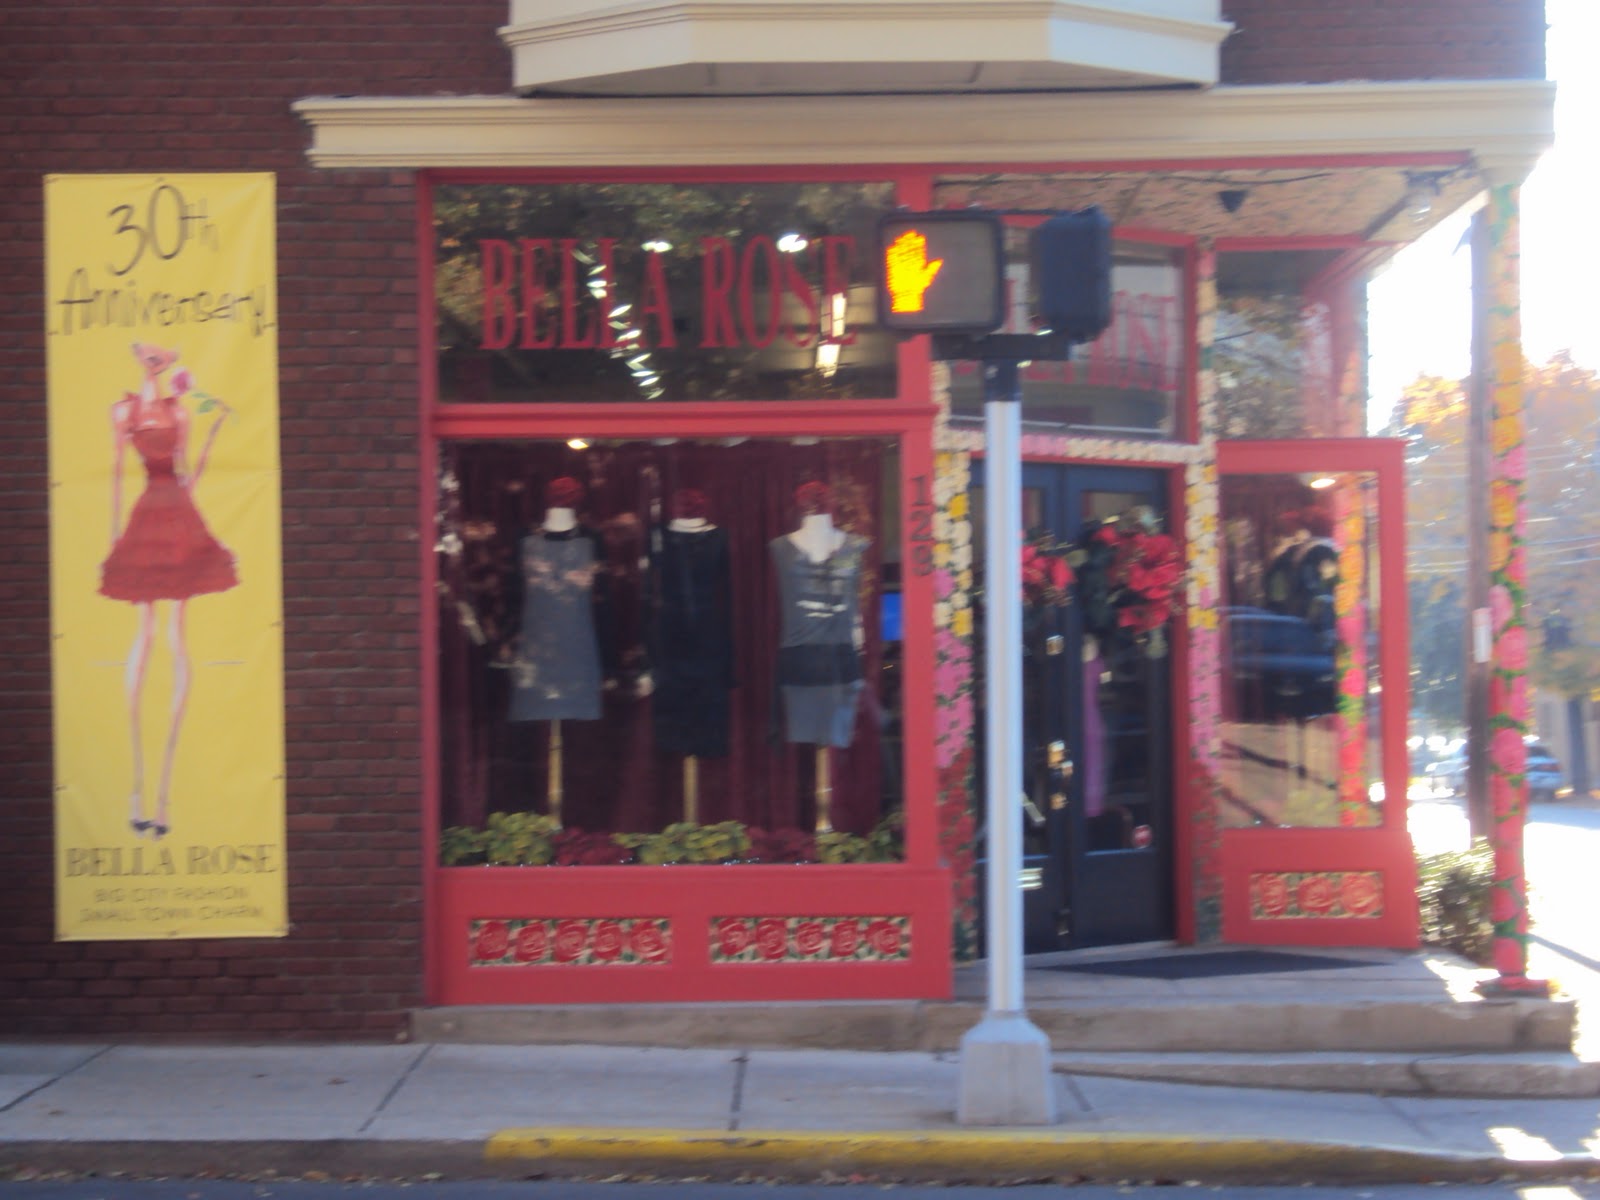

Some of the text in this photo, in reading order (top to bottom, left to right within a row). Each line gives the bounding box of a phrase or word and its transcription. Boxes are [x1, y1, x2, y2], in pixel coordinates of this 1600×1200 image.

[57, 267, 267, 336] Anniversary
[479, 237, 678, 350] BELLA
[700, 235, 857, 350] ROSE
[65, 844, 277, 877] BELLA ROSE
